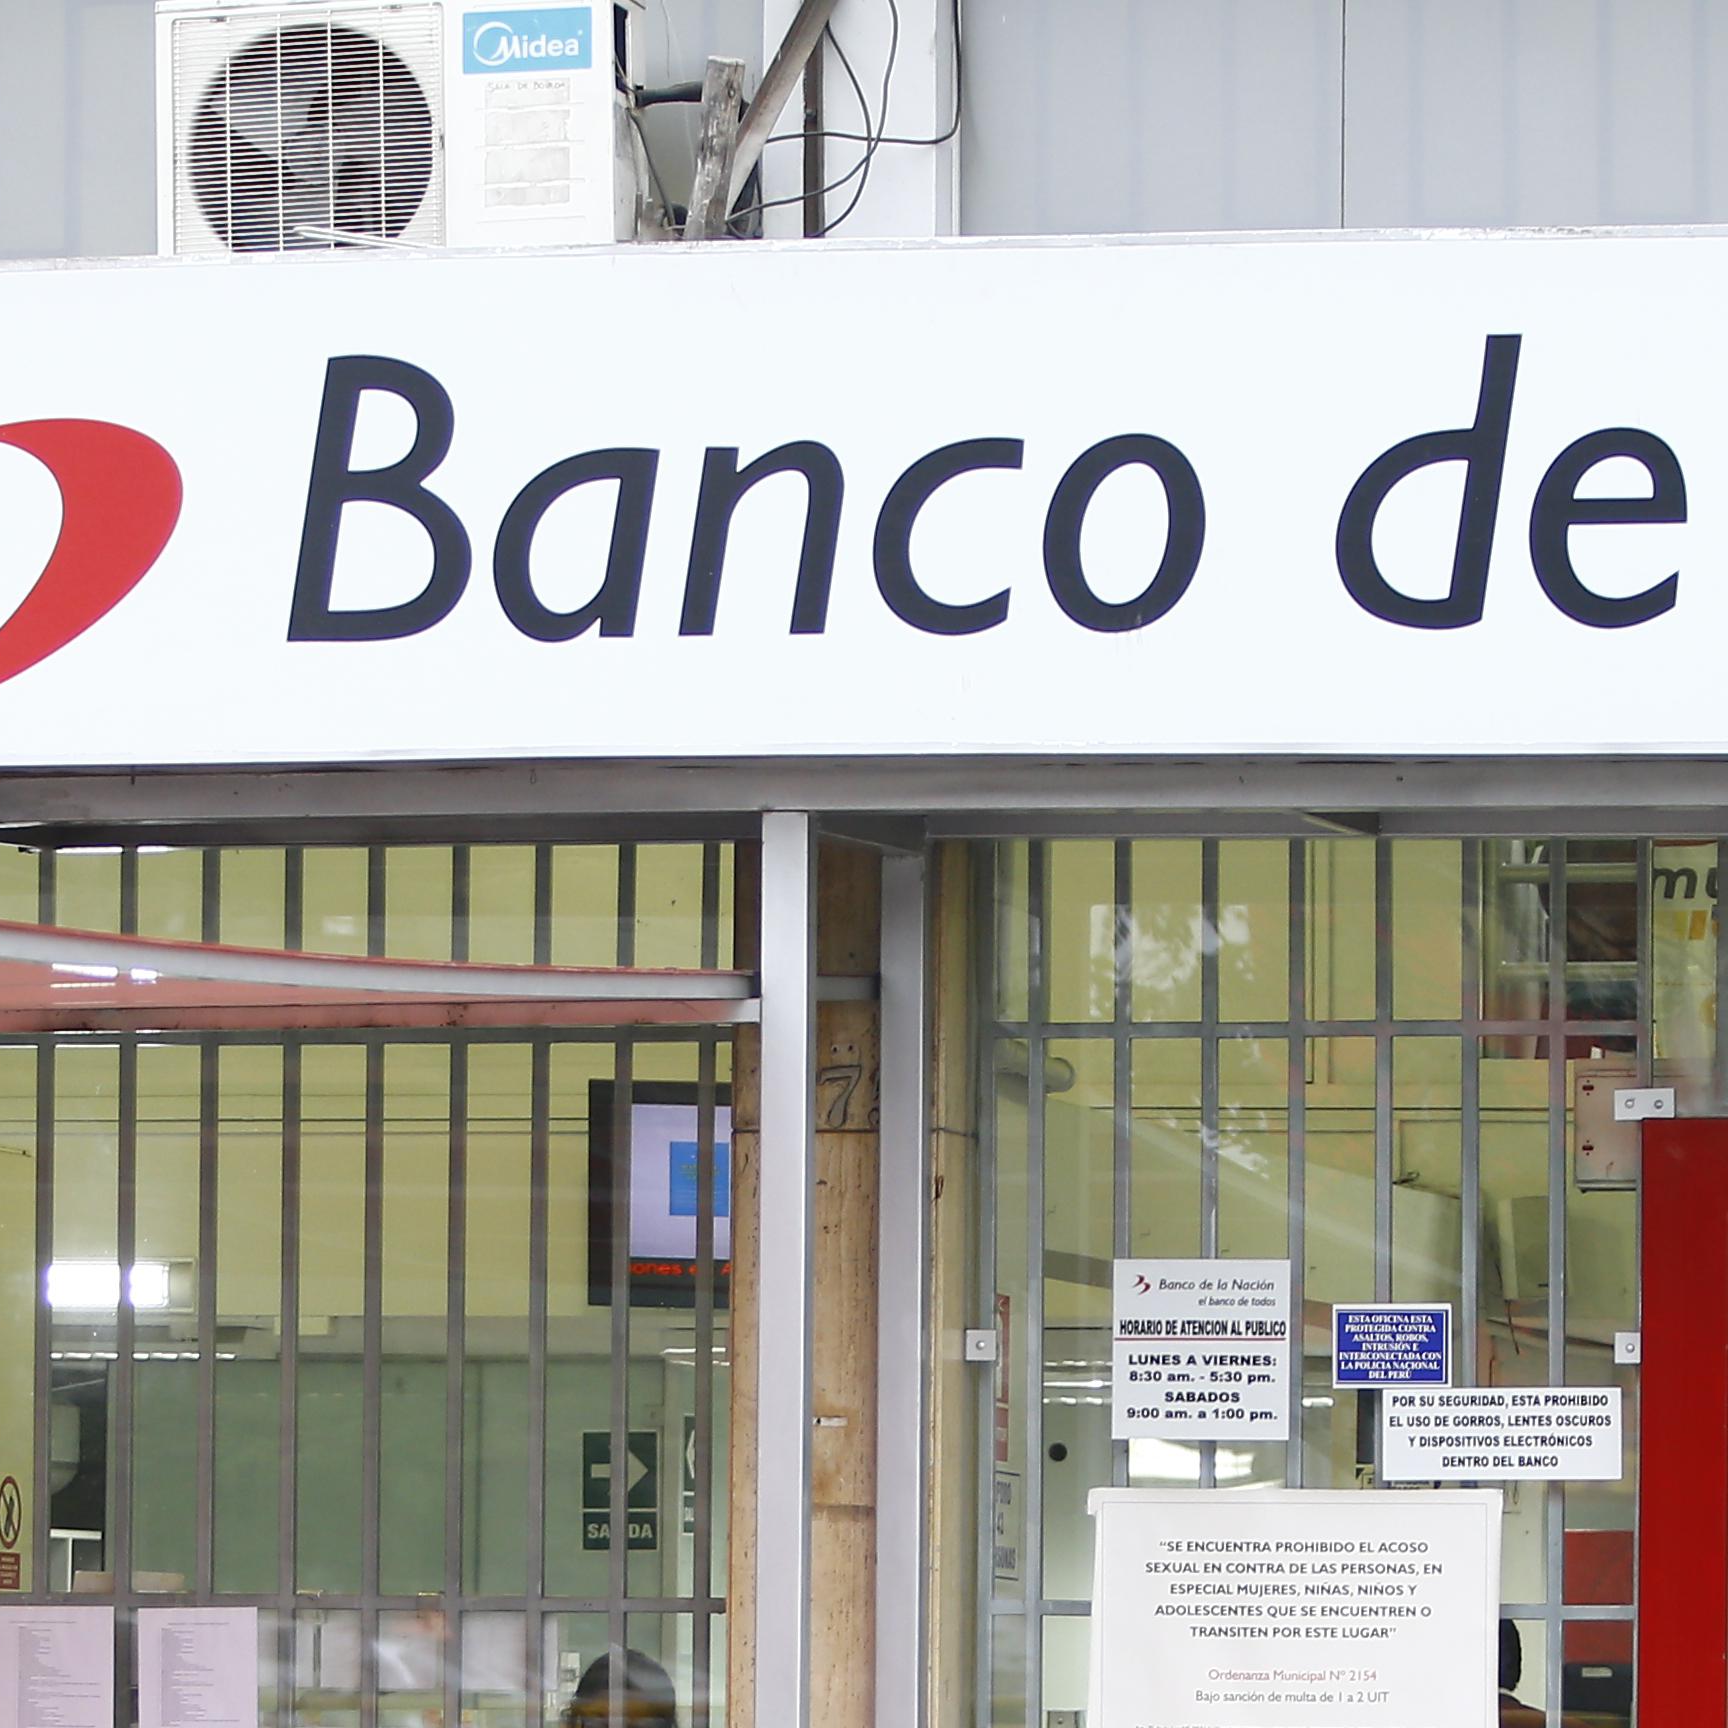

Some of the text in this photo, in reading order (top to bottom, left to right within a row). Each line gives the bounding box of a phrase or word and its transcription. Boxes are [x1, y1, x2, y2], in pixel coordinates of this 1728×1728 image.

[480, 31, 580, 62] Midea
[286, 354, 1206, 643] Banco
[1335, 333, 1688, 631] de
[1158, 1278, 1275, 1291] Banco de la Nación
[1119, 1319, 1287, 1337] HORARIO DE ATENCION AL PUBLICO
[1128, 1354, 1277, 1367] LUNES A VIERNES:
[1129, 1370, 1162, 1382] 8:30
[1167, 1373, 1195, 1382] am.
[1209, 1371, 1243, 1383] 5:30
[1247, 1374, 1276, 1385] pm.
[1164, 1391, 1240, 1403] SABADOS
[1392, 1394, 1609, 1408] POR SU SEGURIDAD, ESTA PROHIBIDO
[1126, 1407, 1278, 1422] 9:00 am. a 1:00 pm.
[1389, 1415, 1612, 1429] EL USO DE GORROS, LENTES OSCUROS
[1408, 1434, 1593, 1448] Y DISPOSITIVOS ELECTRÓNICOS
[1442, 1455, 1559, 1468] DENTRO DEL BANCO
[587, 1523, 654, 1540] SADA
[1159, 1540, 1429, 1553] “SE ENCUENTRA PROHIBIDO EL ACOSO
[1145, 1561, 1443, 1575] SEXUAL EN CONTRA DE LAS PERSONAS, EN
[1170, 1583, 1417, 1598] ESPECIAL MUJERES, NIÑAS, NIÑOS Y
[1154, 1604, 1432, 1619] ADOLESCENTES QUE SE ENCUENTREN O
[1190, 1626, 1396, 1639] TRANSITEN POR ESTE LUGAR”
[1208, 1668, 1377, 1684] Ordenanza Municipal N° 2154
